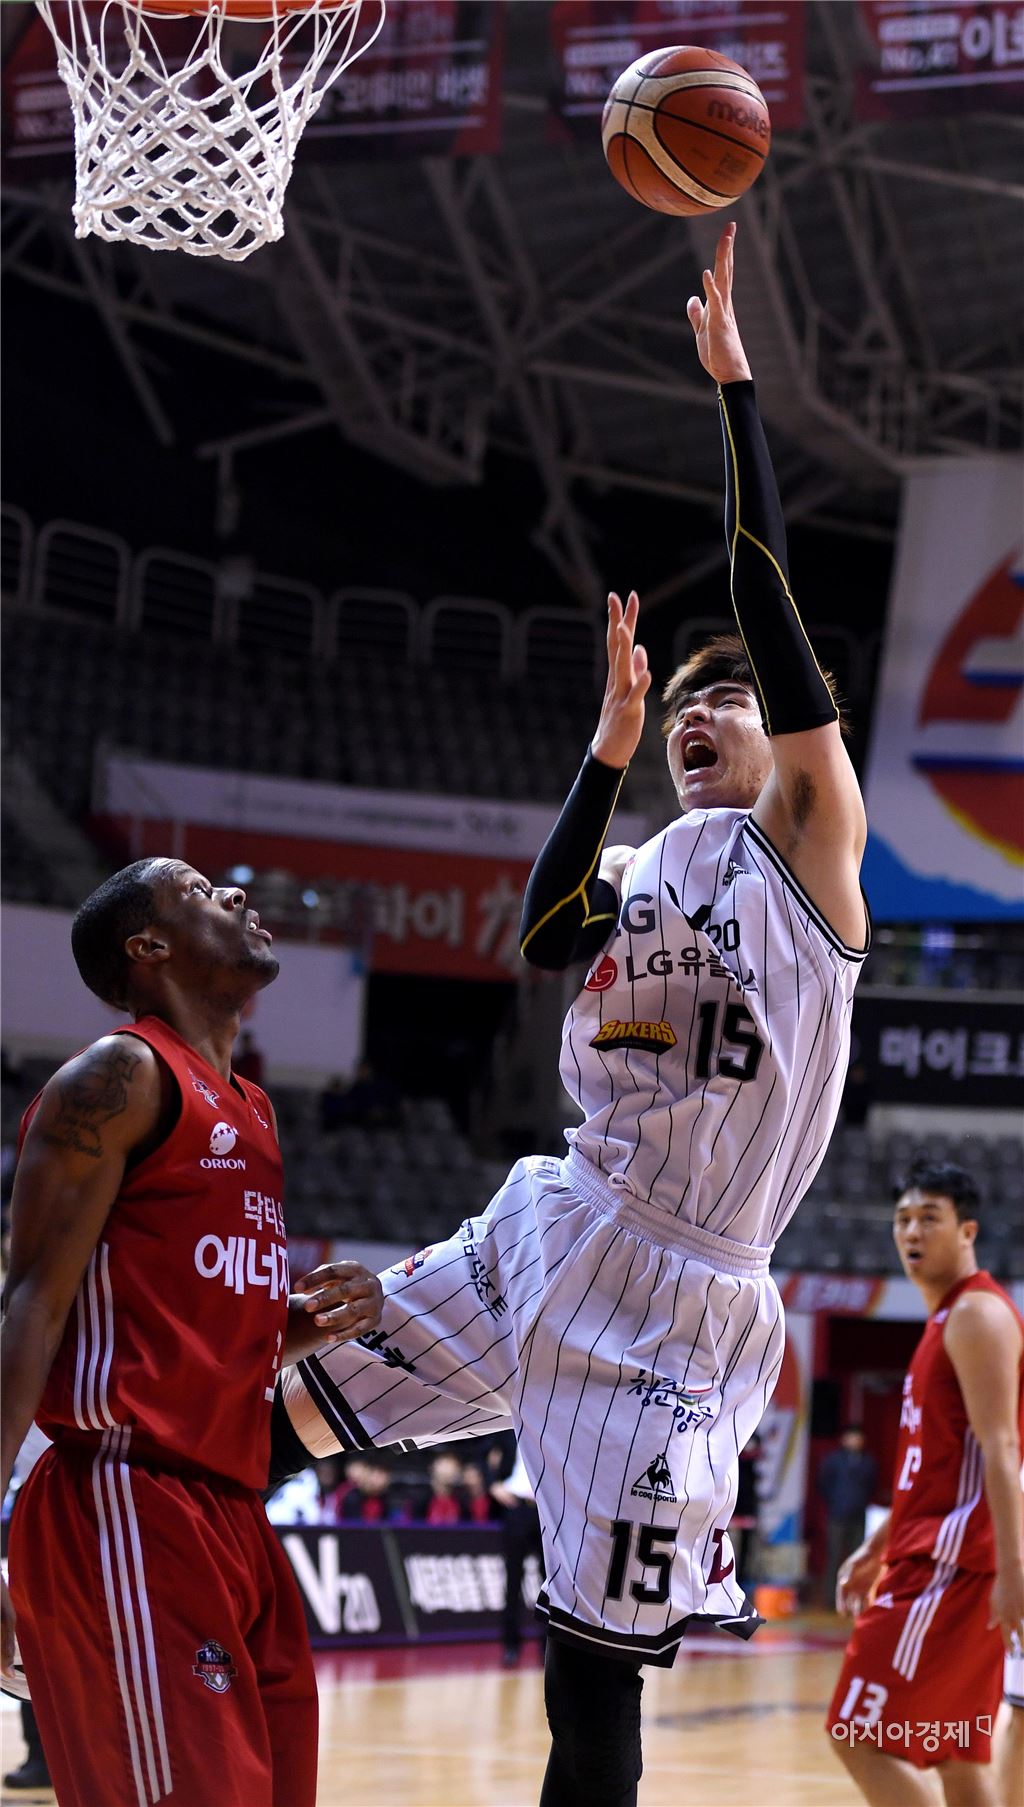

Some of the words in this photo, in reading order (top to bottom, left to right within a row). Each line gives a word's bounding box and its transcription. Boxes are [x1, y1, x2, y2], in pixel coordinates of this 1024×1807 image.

[706, 100, 769, 139] molte
[614, 893, 656, 937] G
[593, 1019, 678, 1047] SAKERS
[695, 1000, 766, 1083] 15
[200, 1157, 246, 1171] ORION
[194, 1234, 290, 1309] 에너지
[605, 1518, 678, 1605] 15
[838, 1675, 888, 1728] 13
